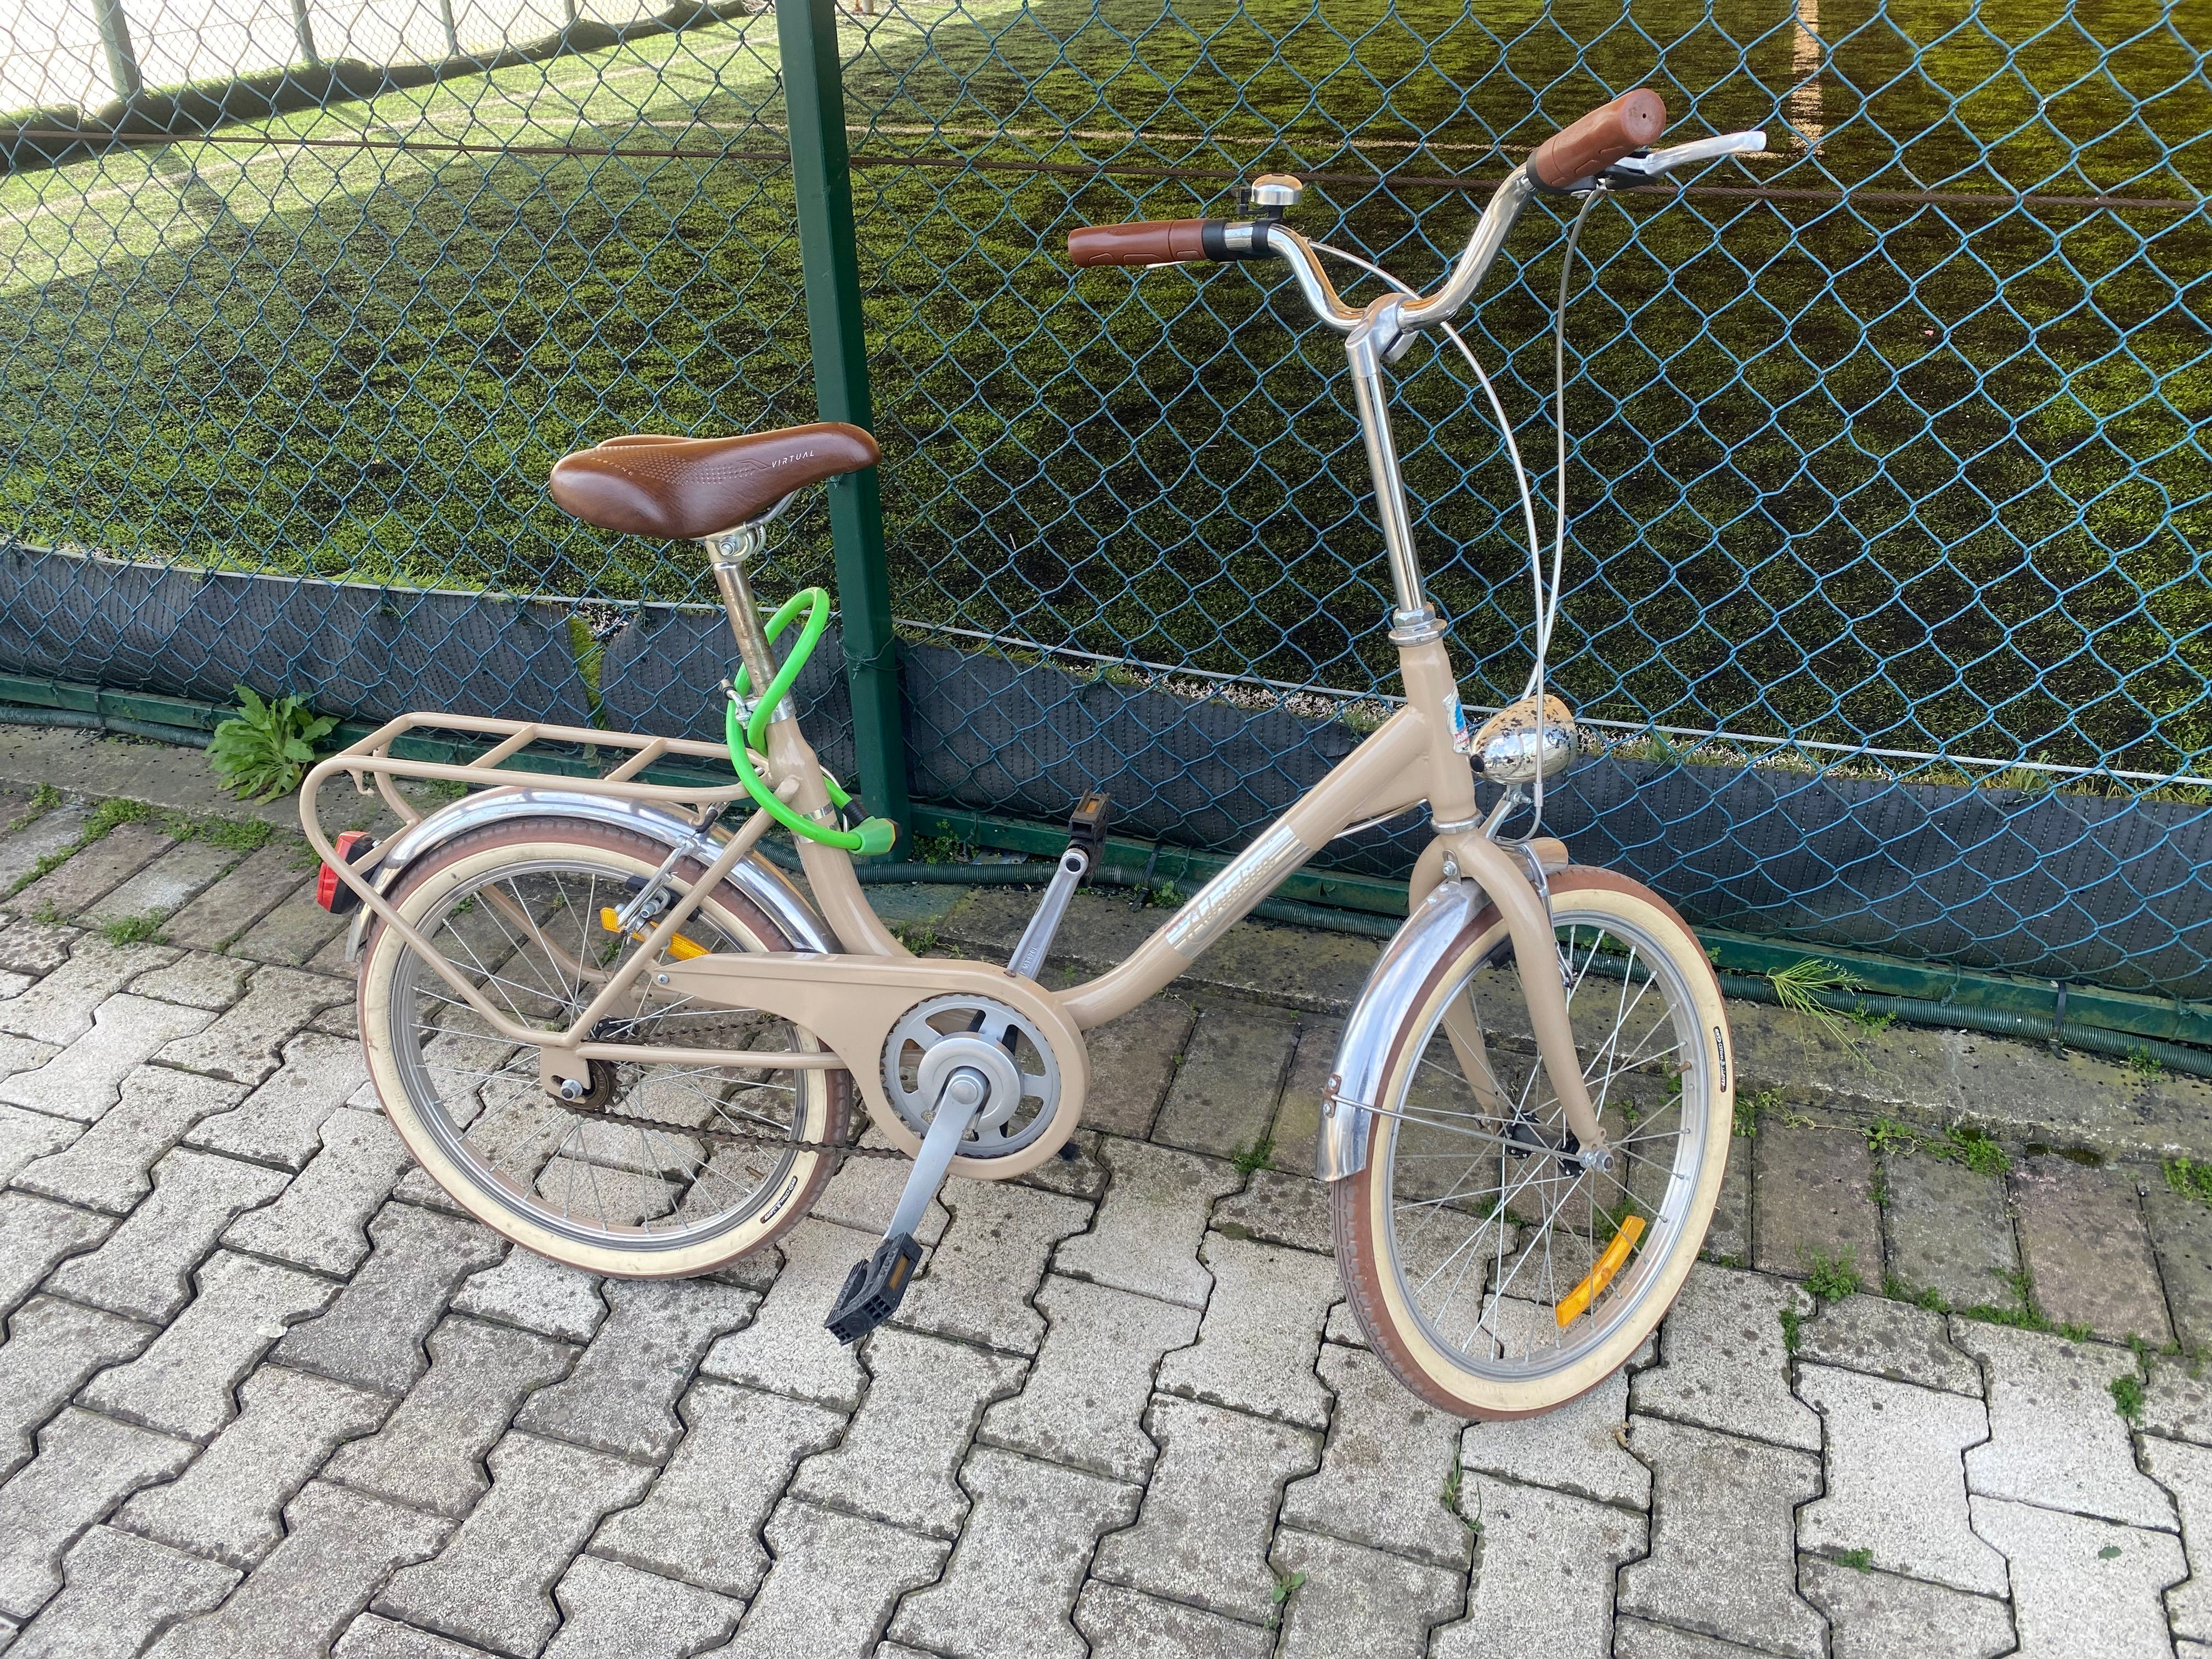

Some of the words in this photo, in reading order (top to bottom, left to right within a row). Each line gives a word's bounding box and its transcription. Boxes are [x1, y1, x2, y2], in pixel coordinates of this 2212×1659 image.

[590, 458, 633, 476] PROZONE
[772, 450, 815, 468] VIRTUAL
[1185, 857, 1276, 945] Adriatica
[764, 1210, 773, 1220] CITY
